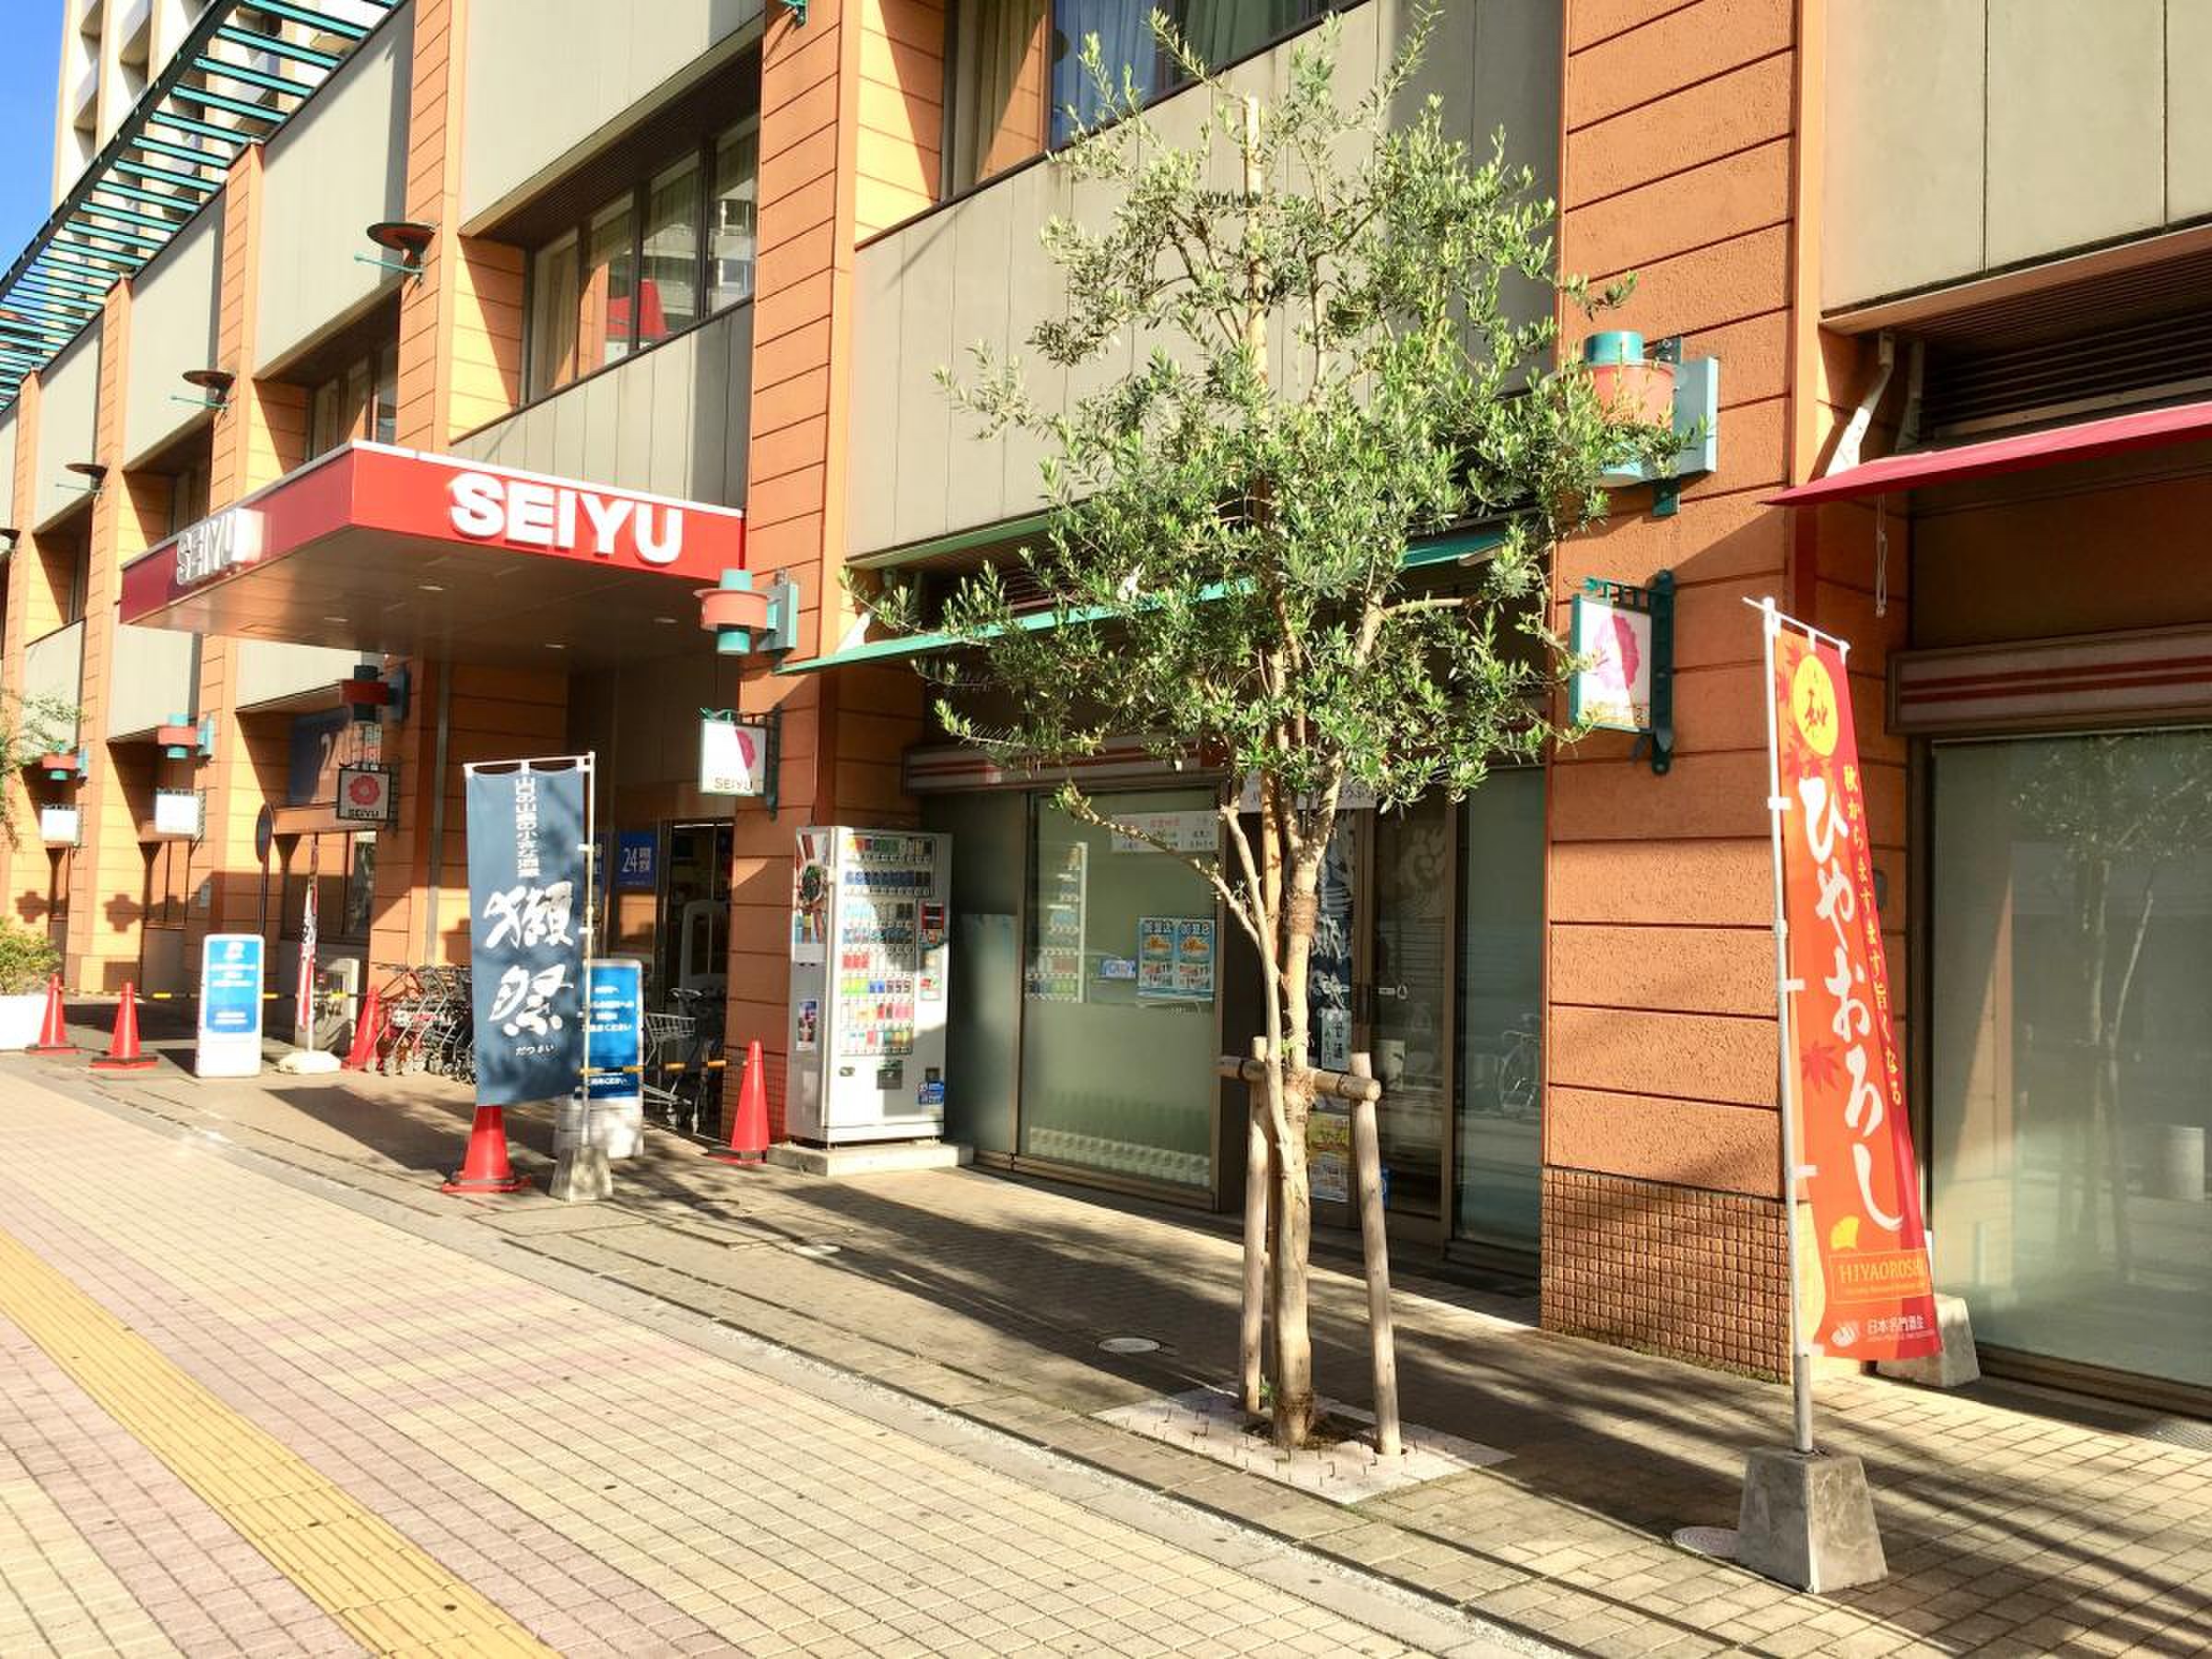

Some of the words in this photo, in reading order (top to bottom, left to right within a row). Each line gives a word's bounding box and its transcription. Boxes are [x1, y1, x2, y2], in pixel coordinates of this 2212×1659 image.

[176, 509, 240, 586] SEIYU
[450, 473, 683, 564] SEIYU
[1798, 777, 1903, 1231] ひやおろし
